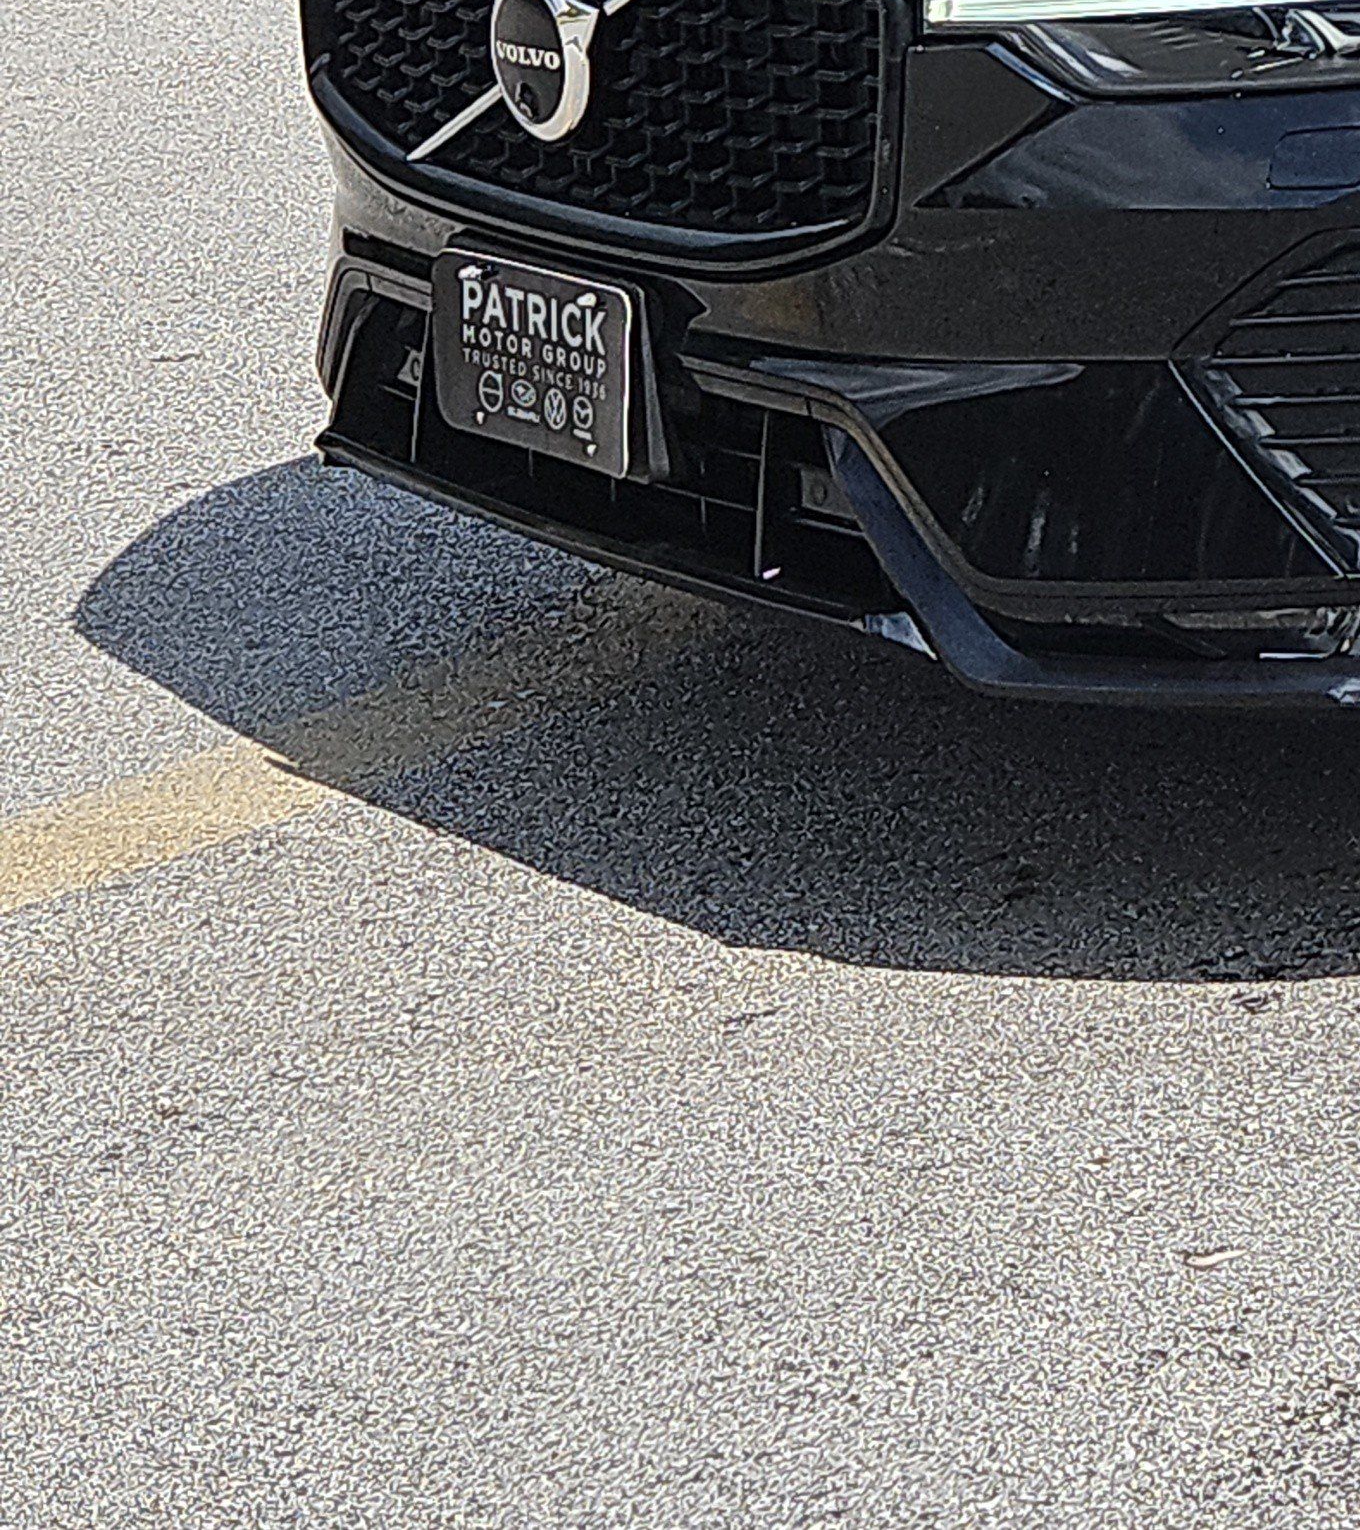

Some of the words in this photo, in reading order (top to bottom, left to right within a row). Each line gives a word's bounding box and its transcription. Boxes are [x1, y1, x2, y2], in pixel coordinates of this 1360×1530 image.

[495, 40, 561, 70] VOLVO
[462, 279, 607, 356] PATRICK
[462, 323, 532, 359] MOTOR
[542, 344, 607, 379] GROUP
[462, 347, 528, 377] TRUSTED
[531, 364, 574, 390] SINCE
